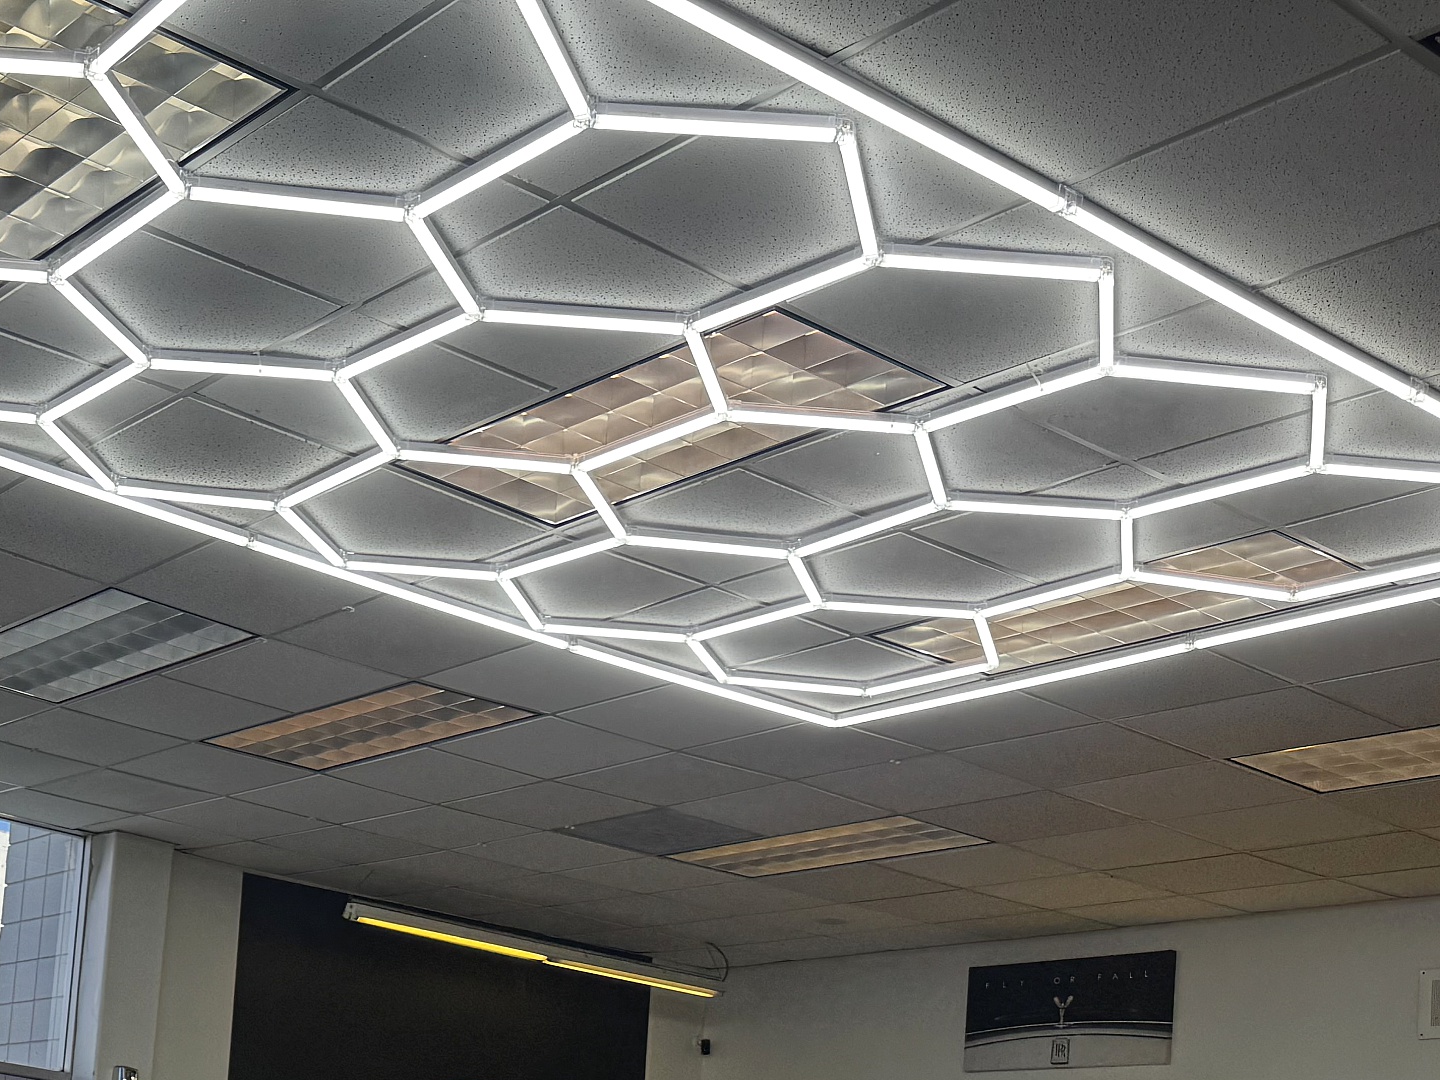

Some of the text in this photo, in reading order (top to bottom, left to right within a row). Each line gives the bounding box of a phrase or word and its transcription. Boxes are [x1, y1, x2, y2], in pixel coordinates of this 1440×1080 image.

[985, 970, 1149, 989] FLY OR FALL
